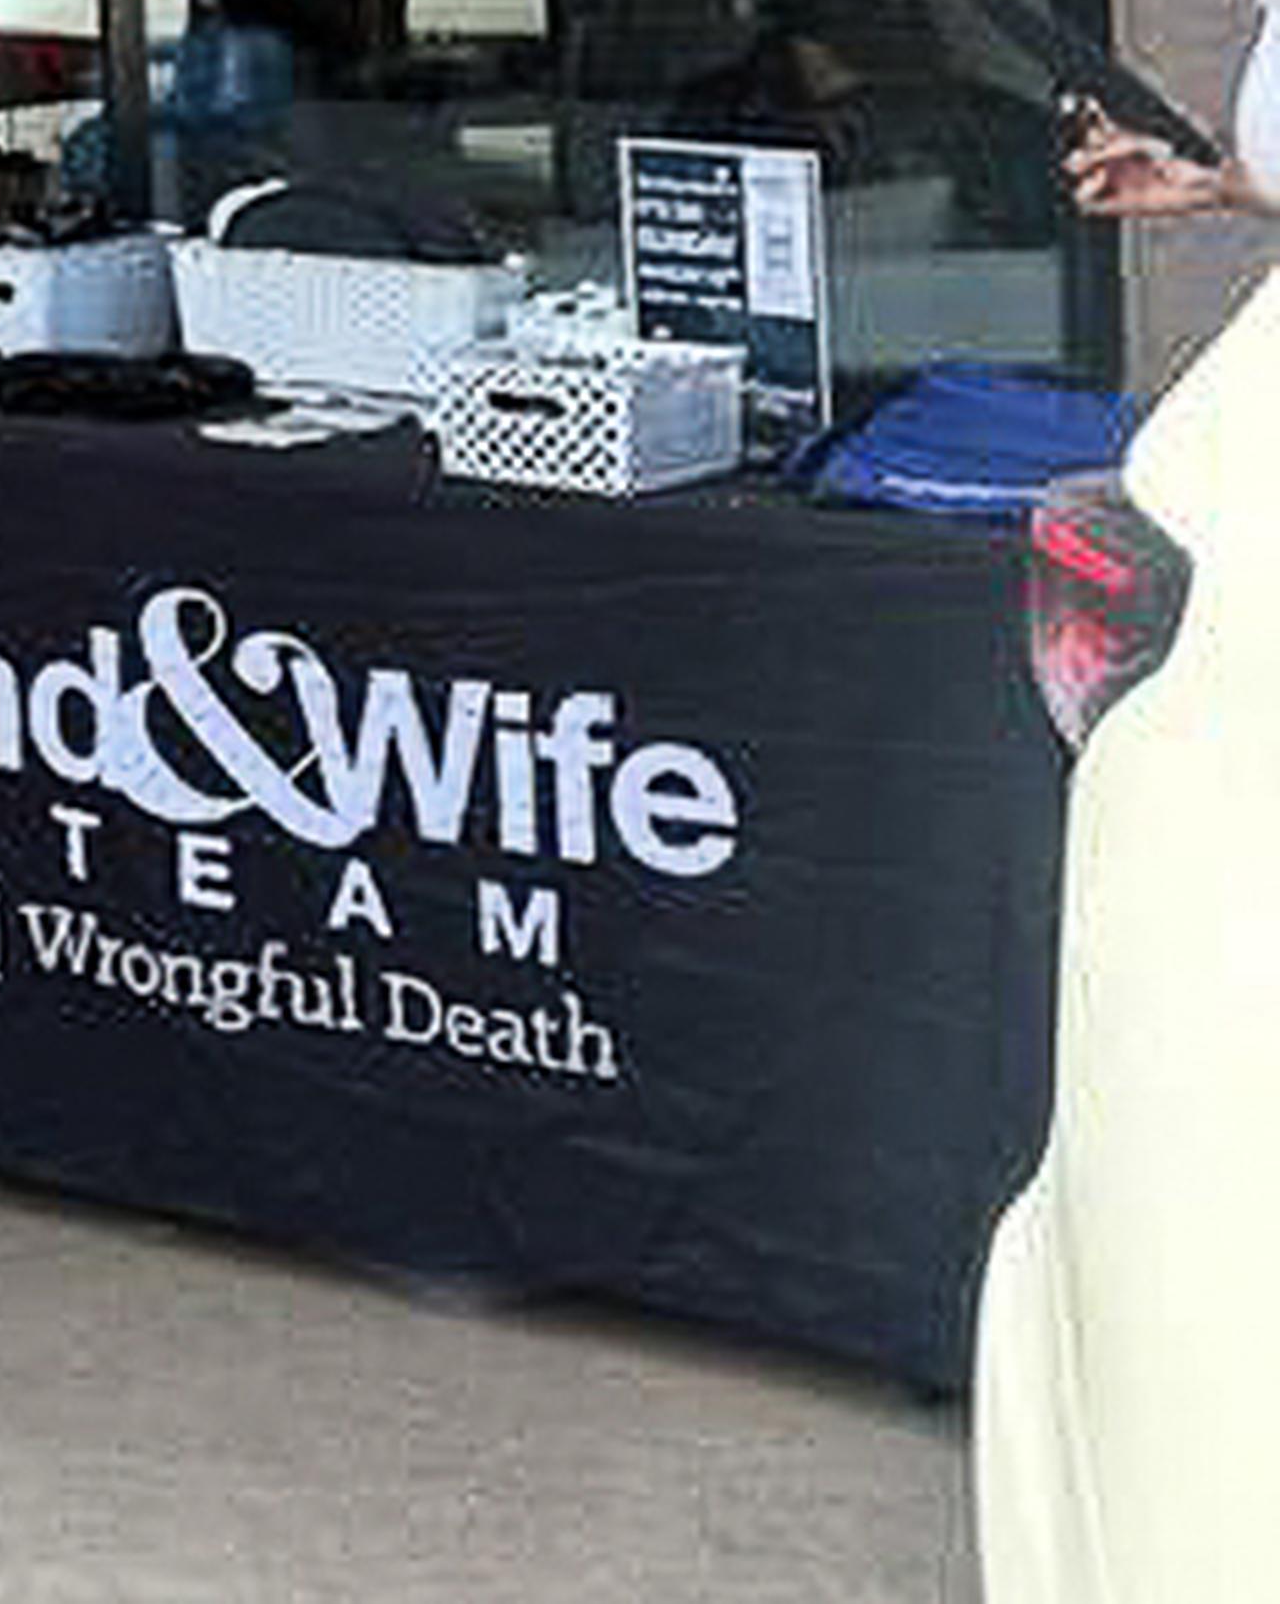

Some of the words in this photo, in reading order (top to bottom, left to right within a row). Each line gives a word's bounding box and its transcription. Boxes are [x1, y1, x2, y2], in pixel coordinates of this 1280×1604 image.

[50, 804, 561, 967] TEAM
[19, 903, 362, 1031] Wrongful
[380, 971, 619, 1078] Death
